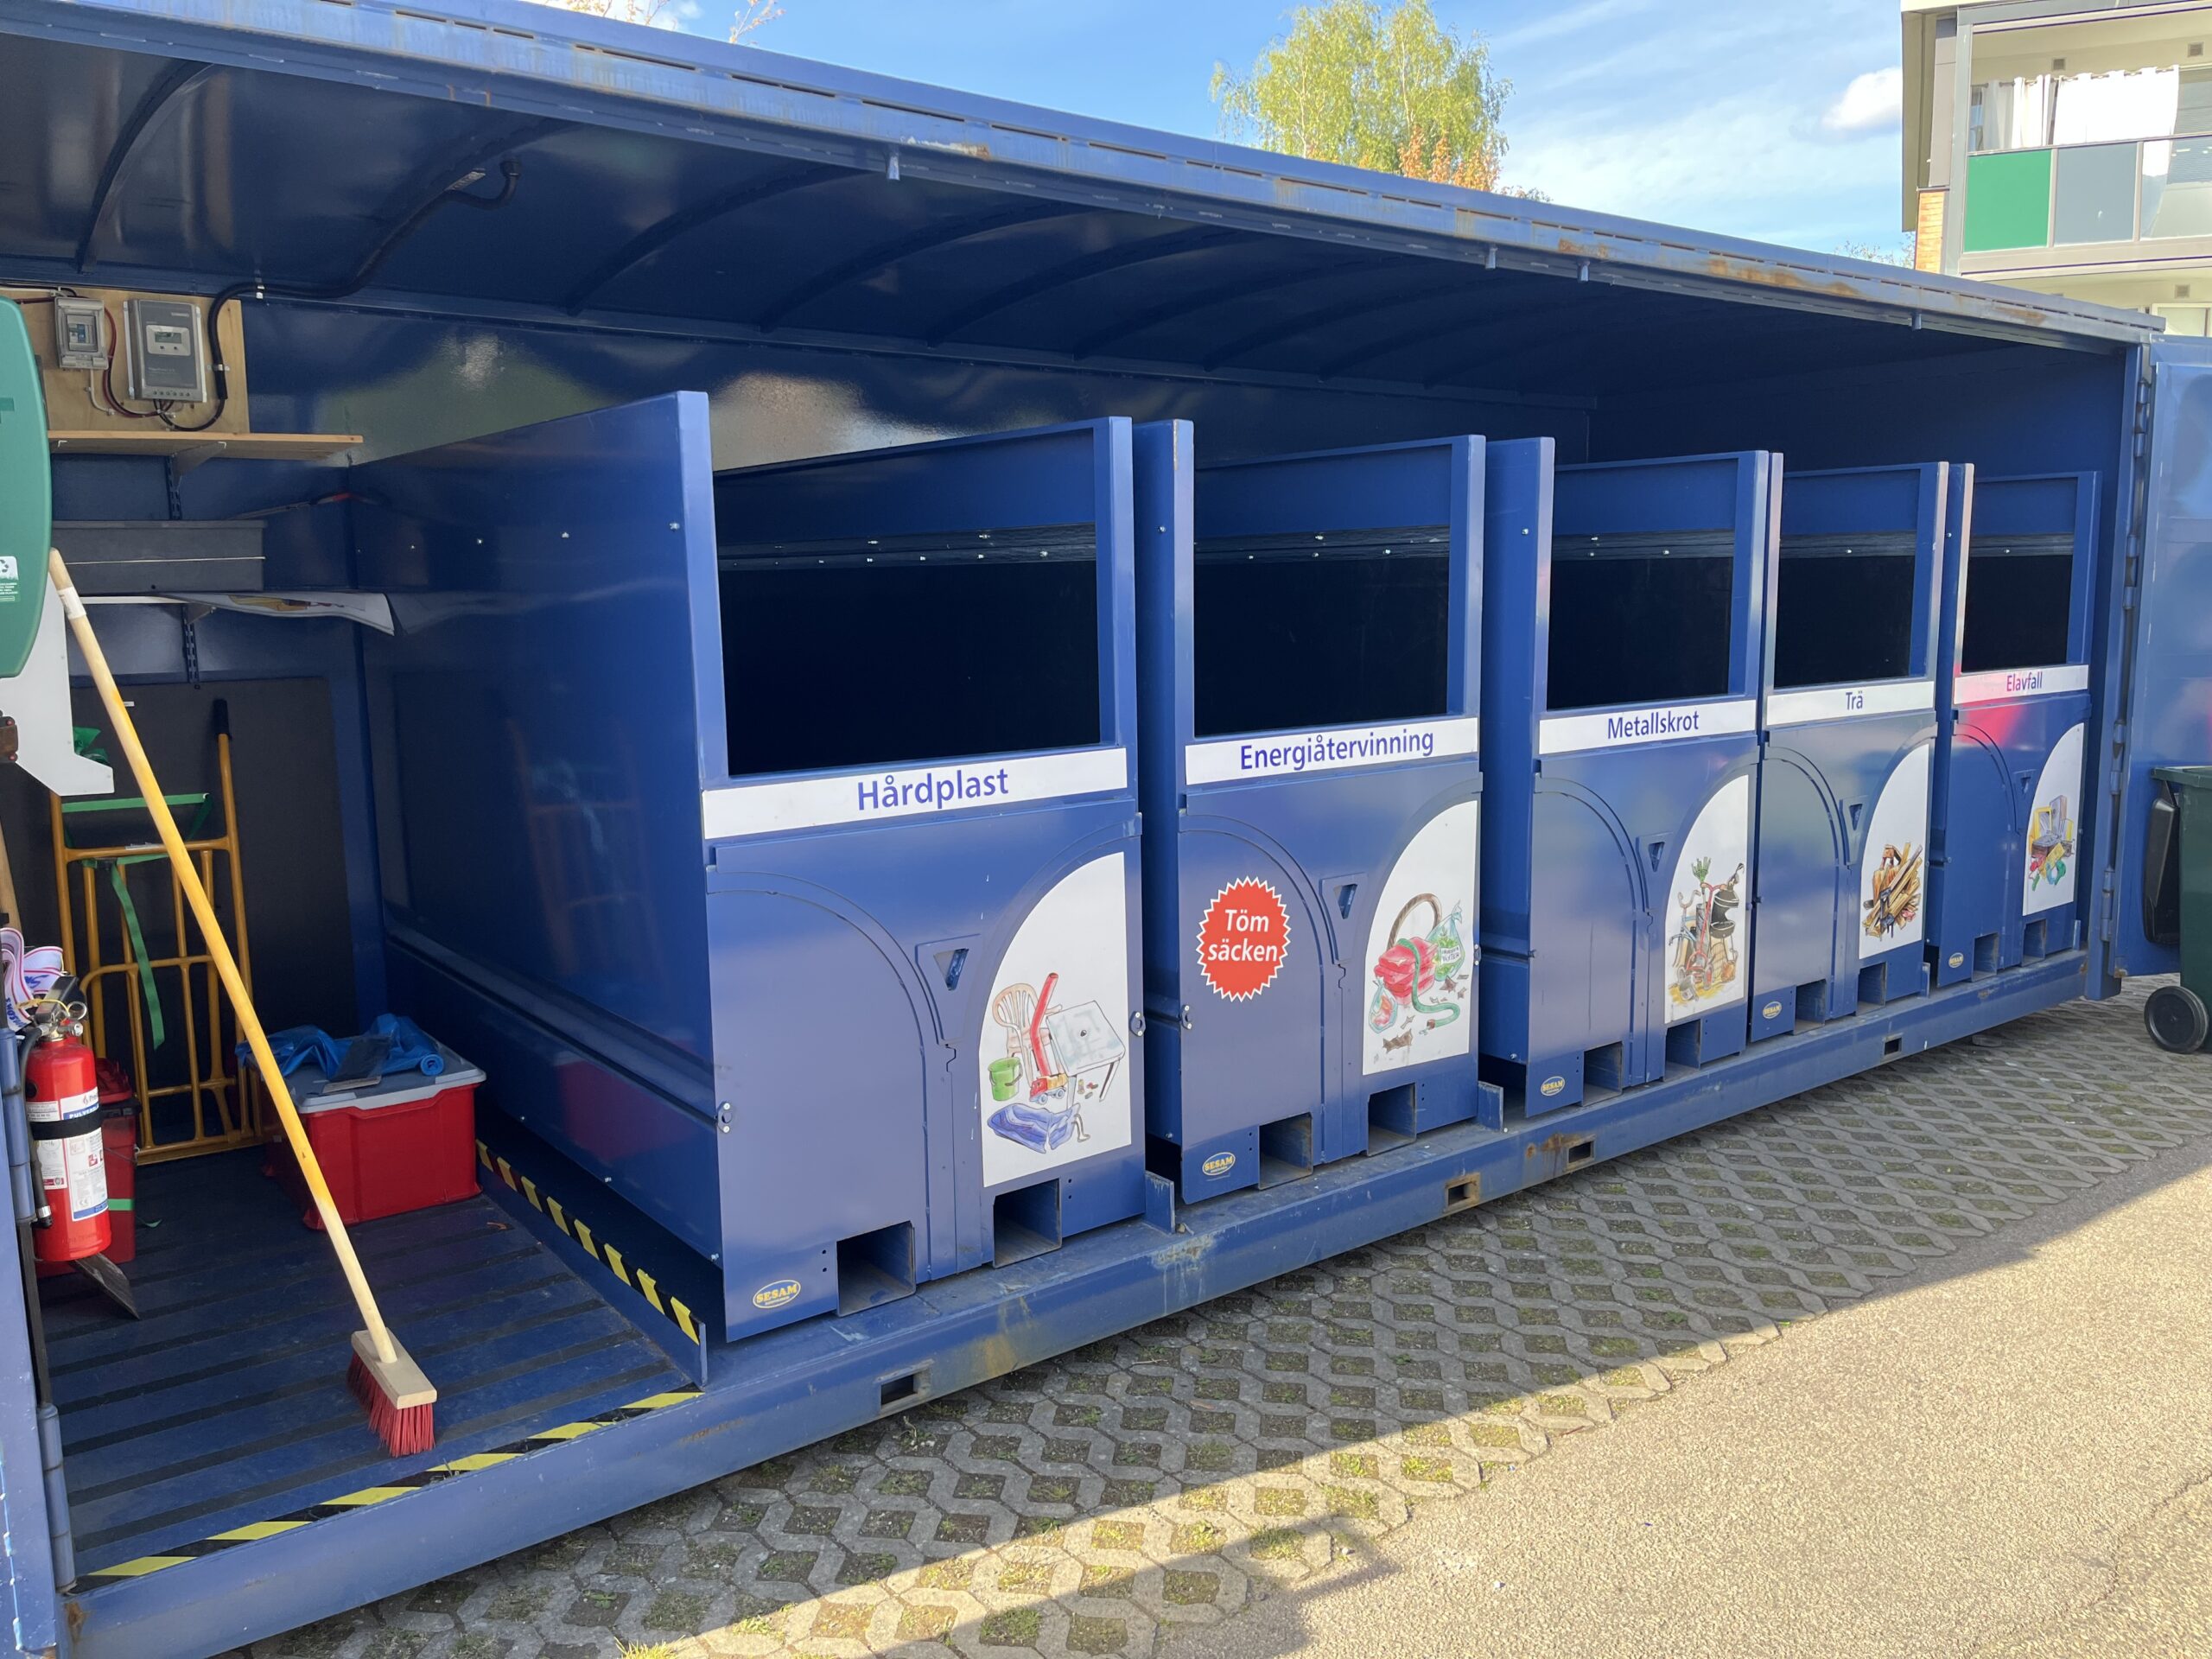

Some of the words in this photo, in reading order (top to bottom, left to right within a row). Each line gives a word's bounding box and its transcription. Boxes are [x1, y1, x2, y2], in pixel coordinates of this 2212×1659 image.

[2006, 674, 2043, 692] Elavfall
[1846, 690, 1864, 710] Trä
[1607, 710, 1700, 740] Metallskrot
[1241, 732, 1433, 771] Energiåtervinning
[857, 768, 1009, 810] Hårdplast
[1225, 909, 1269, 932] Töm
[1207, 938, 1278, 962] säcken
[1205, 1155, 1233, 1172] SESAM
[756, 1283, 798, 1304] SESAM
